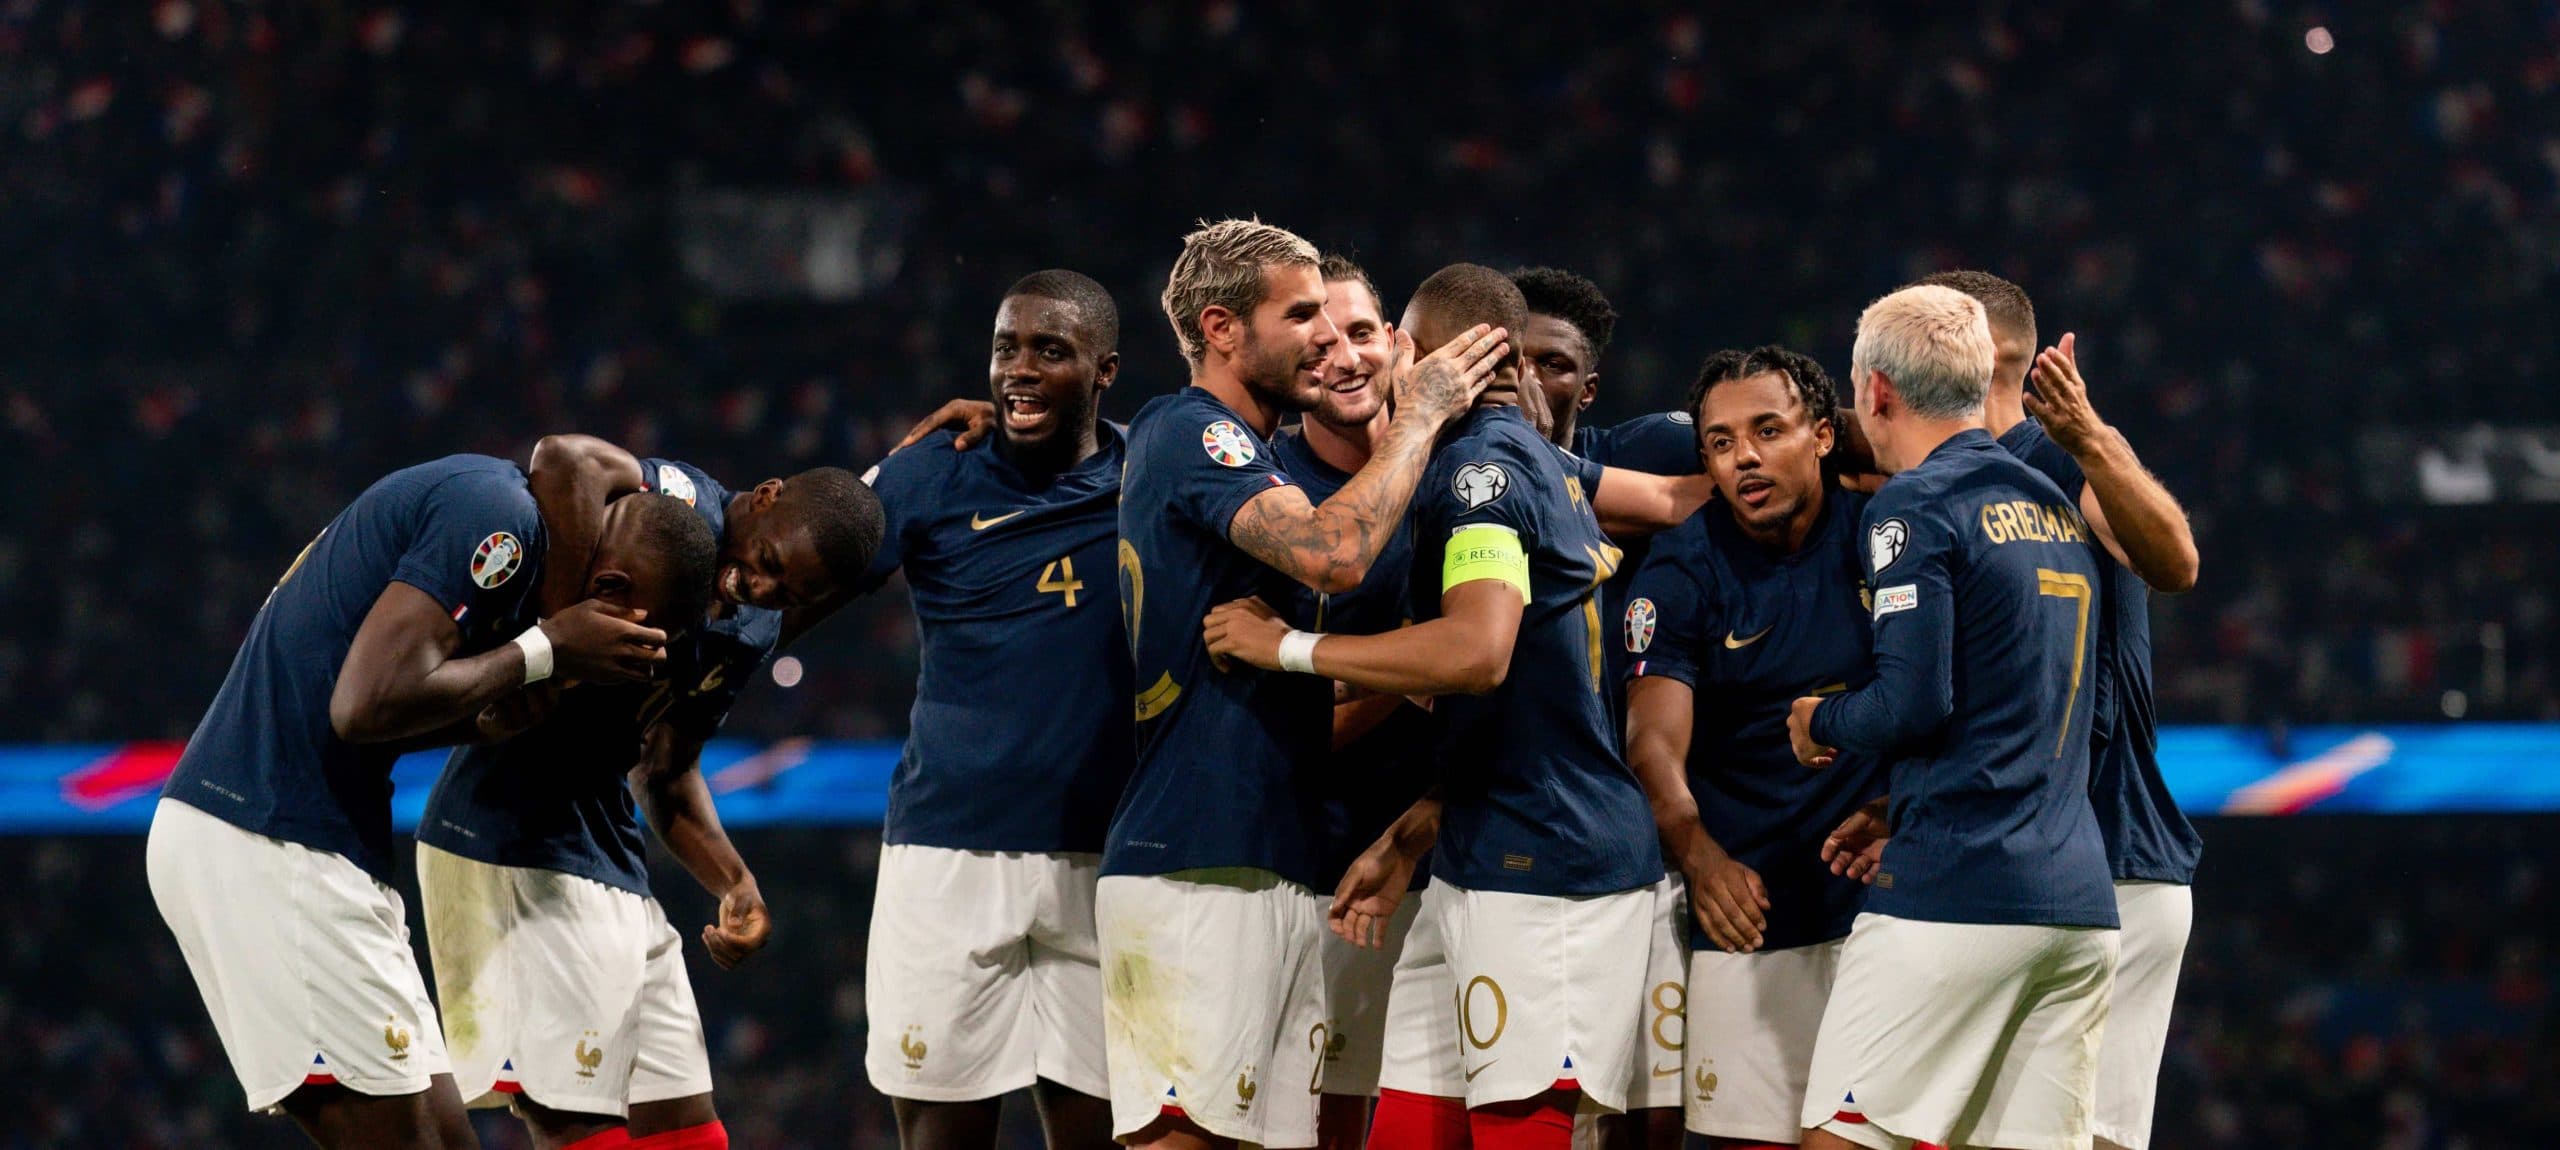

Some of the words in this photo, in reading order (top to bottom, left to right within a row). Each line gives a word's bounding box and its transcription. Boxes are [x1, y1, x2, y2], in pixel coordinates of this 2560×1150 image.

[1036, 555, 1084, 608] 4
[2037, 567, 2092, 759] 7
[1454, 975, 1508, 1056] 10
[1651, 981, 1687, 1051] 8
